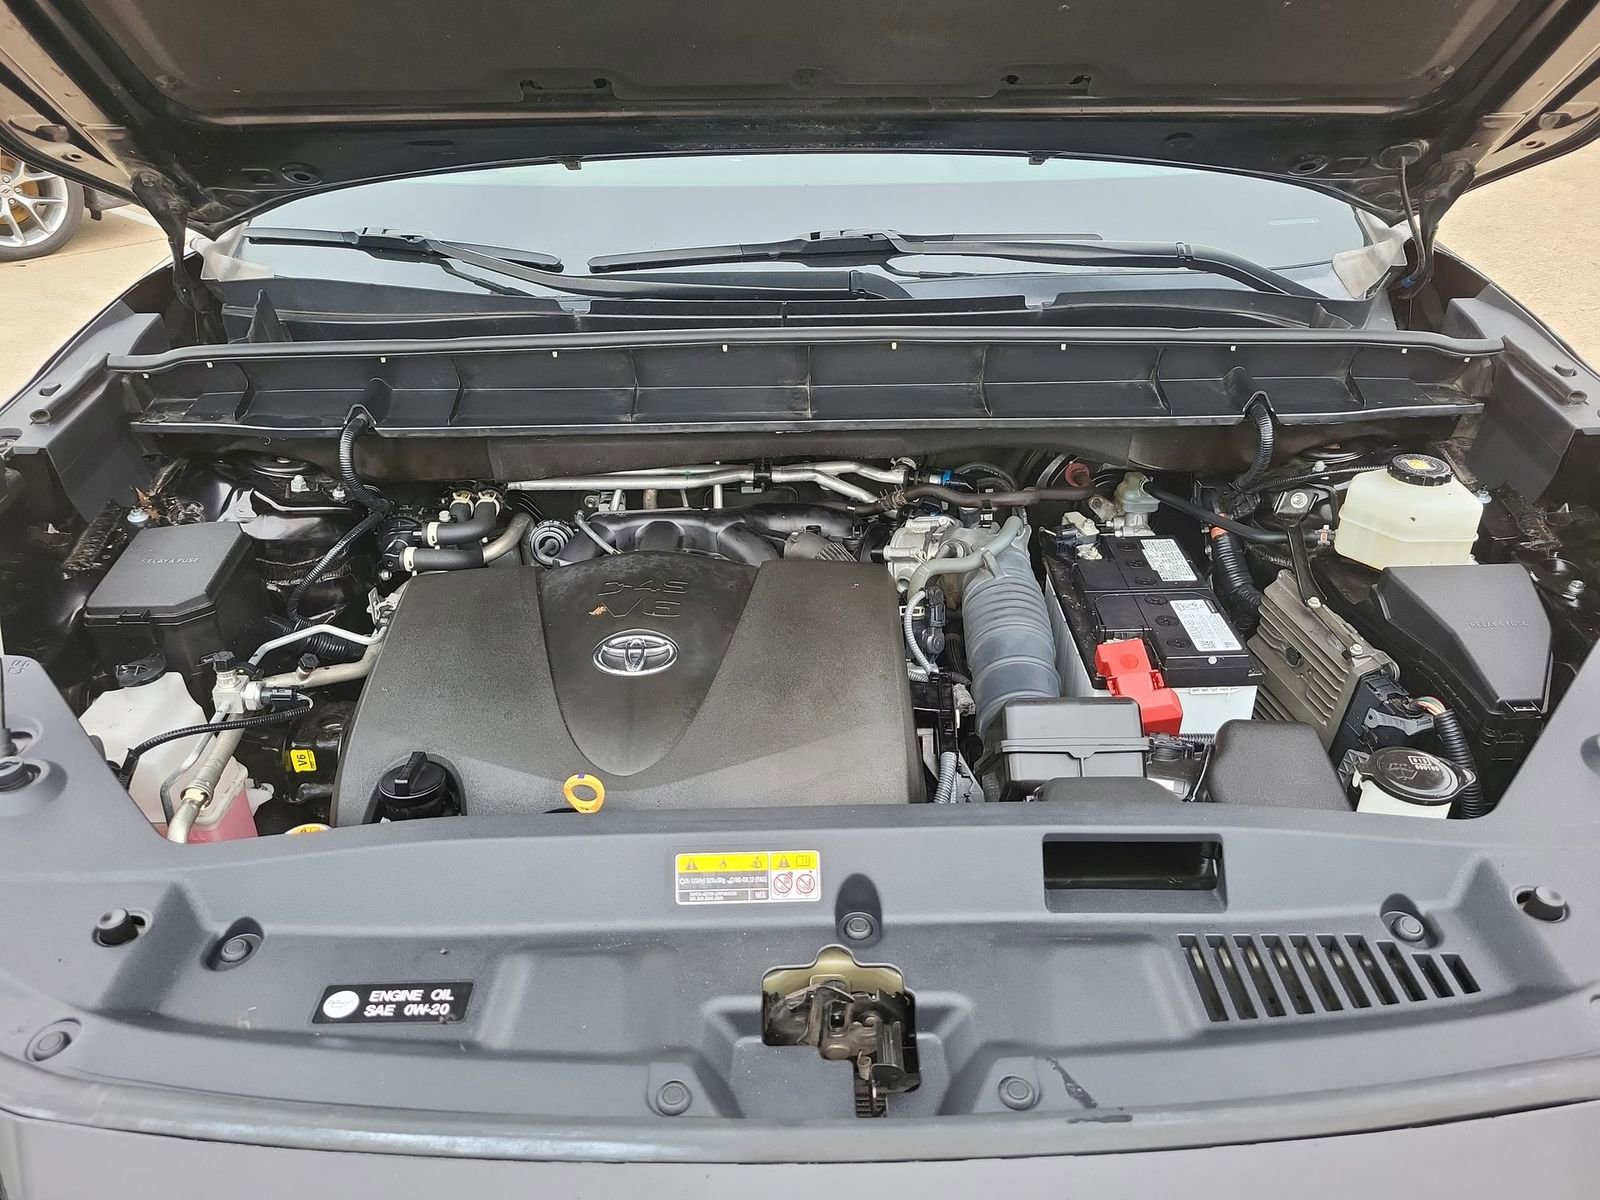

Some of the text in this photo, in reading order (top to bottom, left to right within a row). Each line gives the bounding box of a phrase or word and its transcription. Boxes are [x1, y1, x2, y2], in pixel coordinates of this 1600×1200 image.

[296, 754, 308, 767] V6
[369, 988, 454, 1002] ENGINE OIL
[363, 1003, 450, 1017] SAE 0W-20
